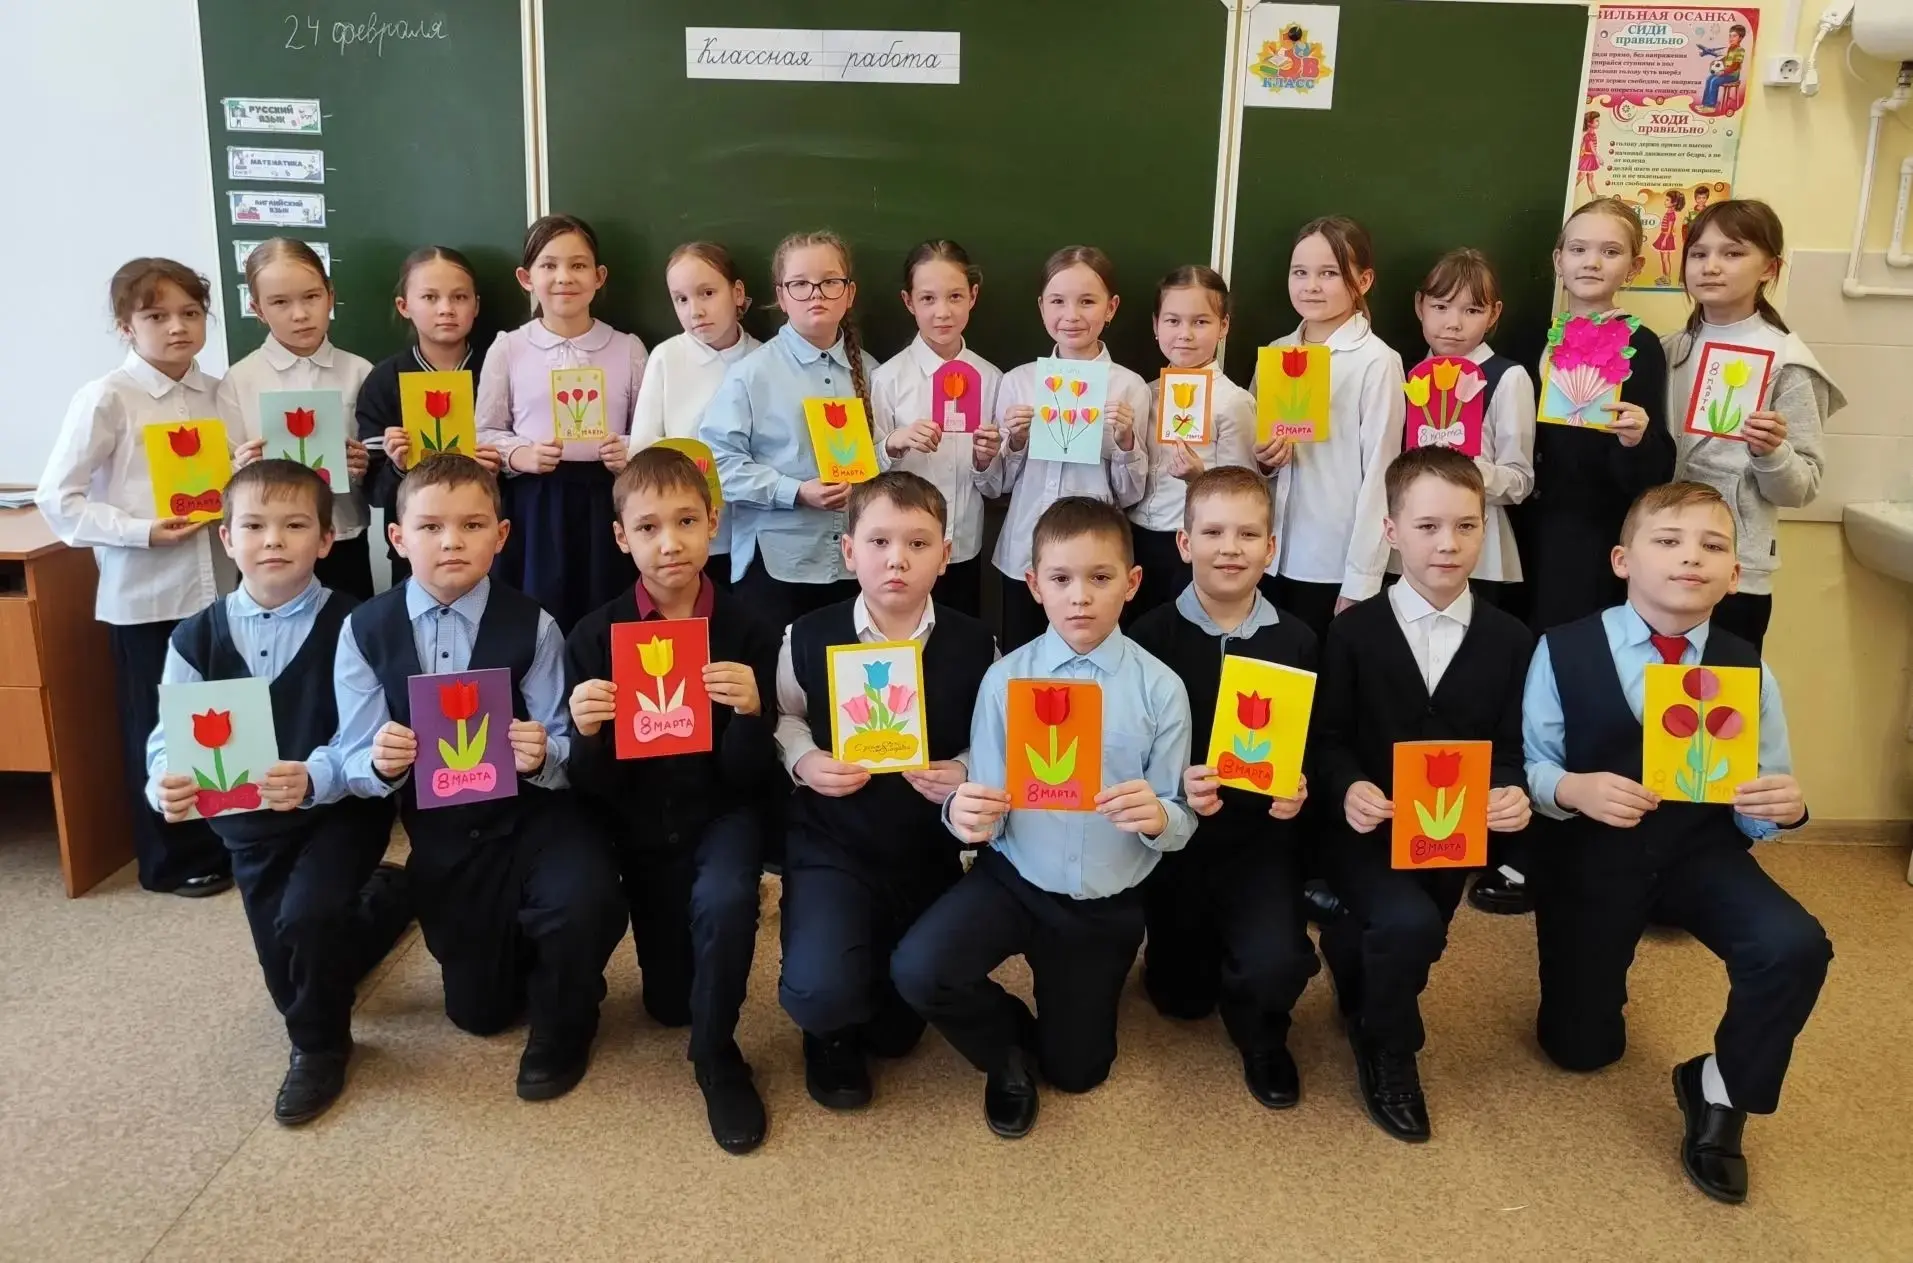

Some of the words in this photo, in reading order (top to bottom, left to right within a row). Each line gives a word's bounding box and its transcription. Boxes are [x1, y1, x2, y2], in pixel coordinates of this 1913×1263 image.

[1673, 11, 1737, 22] ОСАНКА
[284, 14, 320, 50] 24
[332, 11, 449, 57] февраля
[1627, 24, 1667, 36] СИДИ
[1615, 35, 1684, 46] правильно
[696, 35, 813, 66] Классная
[840, 40, 942, 79] работа
[249, 105, 294, 114] РУССКИЙ
[1651, 114, 1688, 126] ХОДИ
[1638, 125, 1704, 135] правильно
[250, 159, 303, 167] МАТЕМАТИКА
[1710, 361, 1720, 376] 8
[1700, 378, 1714, 411] МАРТА
[1276, 424, 1285, 436] 8
[1286, 426, 1312, 435] МАРТА
[1419, 428, 1428, 443] 8
[832, 465, 840, 478] 8
[176, 498, 185, 512] 8
[640, 715, 652, 735] 8
[654, 718, 694, 732] МАРТА
[1223, 758, 1234, 774] 8
[438, 772, 449, 790] 8
[452, 771, 491, 786] МАРТА
[1028, 783, 1039, 802] 8
[1041, 788, 1078, 799] МАРТА
[1415, 839, 1426, 856] 8
[1428, 842, 1461, 852] МАРТА
